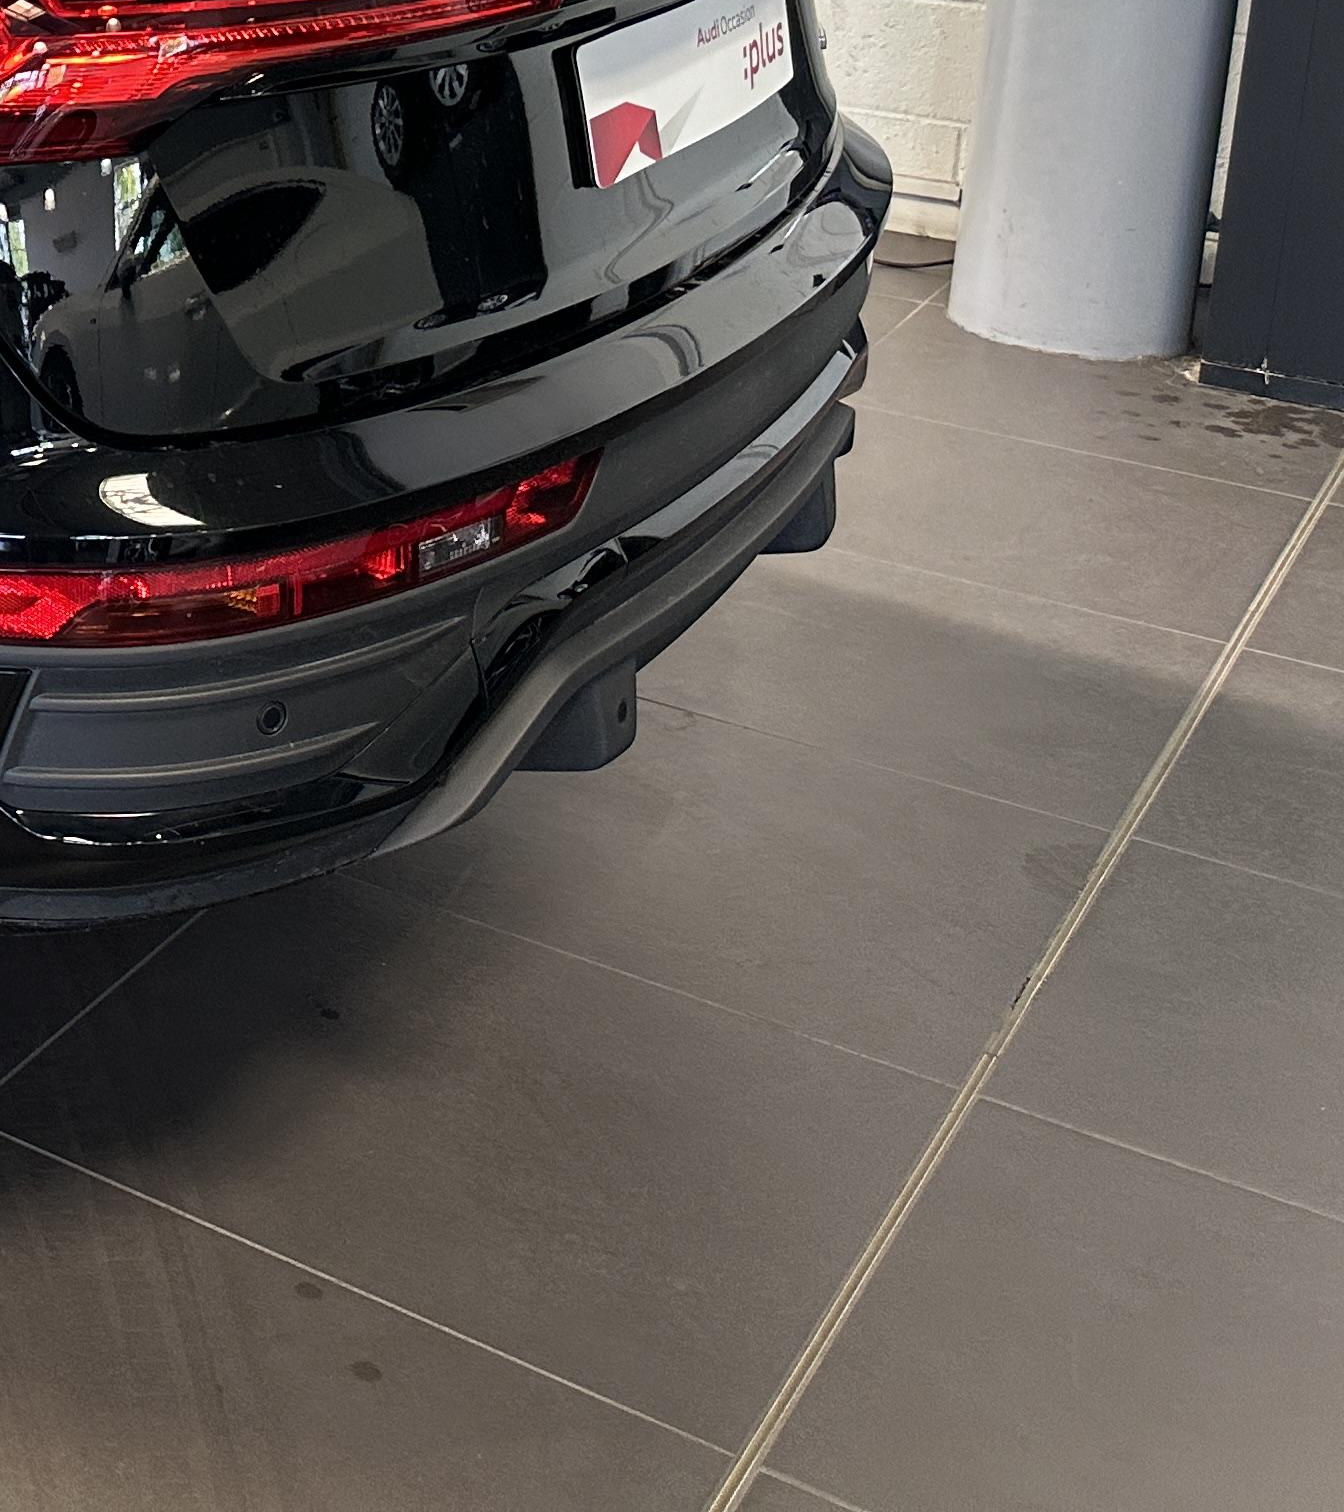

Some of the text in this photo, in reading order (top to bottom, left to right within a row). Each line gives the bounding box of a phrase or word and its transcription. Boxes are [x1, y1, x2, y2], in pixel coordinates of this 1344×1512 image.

[696, 4, 756, 48] Audi Occasion
[742, 21, 784, 89] :plus
